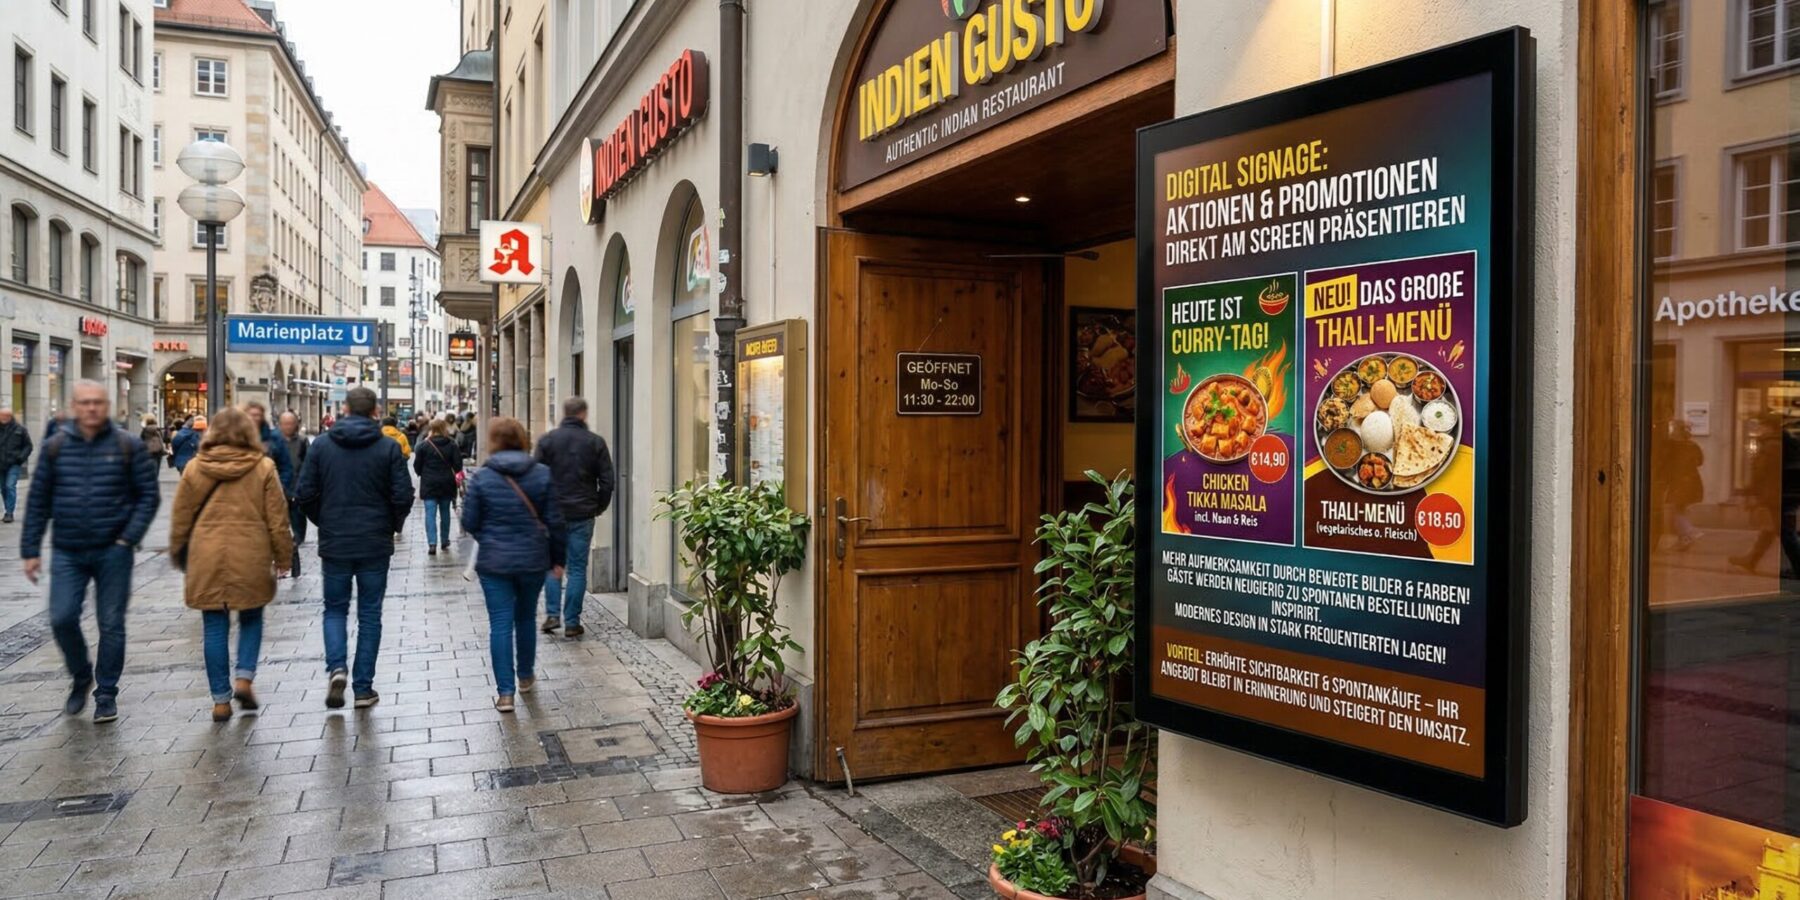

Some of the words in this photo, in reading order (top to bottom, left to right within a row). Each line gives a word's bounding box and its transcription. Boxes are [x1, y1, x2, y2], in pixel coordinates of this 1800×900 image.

[860, 32, 955, 141] INDIEN
[595, 111, 636, 199] INDIEN
[639, 49, 693, 157] GUSTO
[886, 123, 938, 163] AUTHENTIC
[941, 104, 978, 138] INDIAN
[982, 62, 1066, 120] RESTAURANT
[1166, 163, 1232, 201] DIGITAL
[1237, 139, 1329, 188] SIGNAGE:
[1166, 193, 1255, 236] AKTIONEN
[1260, 188, 1274, 220] &
[1279, 156, 1438, 217] PROMOTIONEN
[1166, 235, 1218, 266] DIREKT
[1221, 229, 1246, 258] AM
[1250, 220, 1315, 253] SCREEN
[1319, 195, 1466, 243] PRÄSENTIEREN
[1171, 299, 1216, 324] HEUTE
[1220, 296, 1243, 320] IST
[1313, 281, 1351, 312] NEU!
[1360, 278, 1396, 306] DAS
[1654, 286, 1800, 326] Apotheke
[237, 322, 344, 344] Marienplatz
[352, 325, 368, 344] U
[1171, 322, 1269, 355] CURRY-TAG!
[1315, 303, 1452, 348] THALI-MENÜ
[907, 360, 973, 375] GEÖFFNET
[903, 393, 934, 406] 11:30
[944, 394, 976, 406] 22:00
[920, 378, 959, 391] Mo-So
[1251, 452, 1286, 468] €14,90
[1202, 473, 1250, 492] CHICKEN
[1187, 491, 1218, 509] TIKKA
[1220, 493, 1267, 512] MASALA
[1320, 500, 1406, 525] THALI-MENÜ
[1194, 511, 1210, 524] incl.
[1233, 513, 1239, 526] &
[1240, 514, 1258, 527] Reis
[1374, 530, 1383, 539] o.
[1384, 528, 1418, 542] Fleisch)
[1417, 510, 1462, 530] €18,50
[1162, 550, 1187, 567] MEHR
[1187, 553, 1271, 577] AUFMERKSAMKEIT
[1273, 564, 1307, 583] DURCH
[1309, 568, 1359, 590] BEWEGTE
[1361, 575, 1402, 596] BILDER
[1405, 580, 1414, 598] &
[1417, 581, 1471, 605] FARBEN!
[1167, 567, 1194, 585] GÄSTE
[1195, 572, 1233, 591] WERDEN
[1234, 578, 1284, 599] NEUGIERIG
[1286, 584, 1299, 601] ZU
[1301, 586, 1365, 611] SPONTANEN
[1367, 596, 1461, 625] BESTELLUNGEN
[1271, 600, 1322, 623] INSPIRIRT.
[1174, 602, 1222, 624] MODERNES
[1223, 611, 1256, 630] DESIGN
[1258, 617, 1268, 633] IN
[1270, 618, 1302, 639] STARK
[1304, 624, 1399, 657] FREQUENTIERTEN
[1402, 640, 1447, 664] LAGEN!
[1166, 642, 1204, 664] VORTEIL:
[1205, 650, 1247, 674] ERHÖHTE
[1248, 660, 1320, 690] SICHTBARKEIT
[1322, 675, 1330, 691] &
[1331, 677, 1422, 712] SPONTANKÄUFE
[1437, 698, 1460, 720] IHR
[1160, 660, 1200, 683] ANGEBOT
[1200, 669, 1232, 691] BLEIBT
[1233, 676, 1244, 693] IN
[1245, 679, 1307, 708] ERINNERUNG
[1308, 693, 1331, 714] UND
[1333, 699, 1386, 726] STEIGERT
[1388, 711, 1413, 733] DEN
[1415, 717, 1471, 747] UMSATZ.
